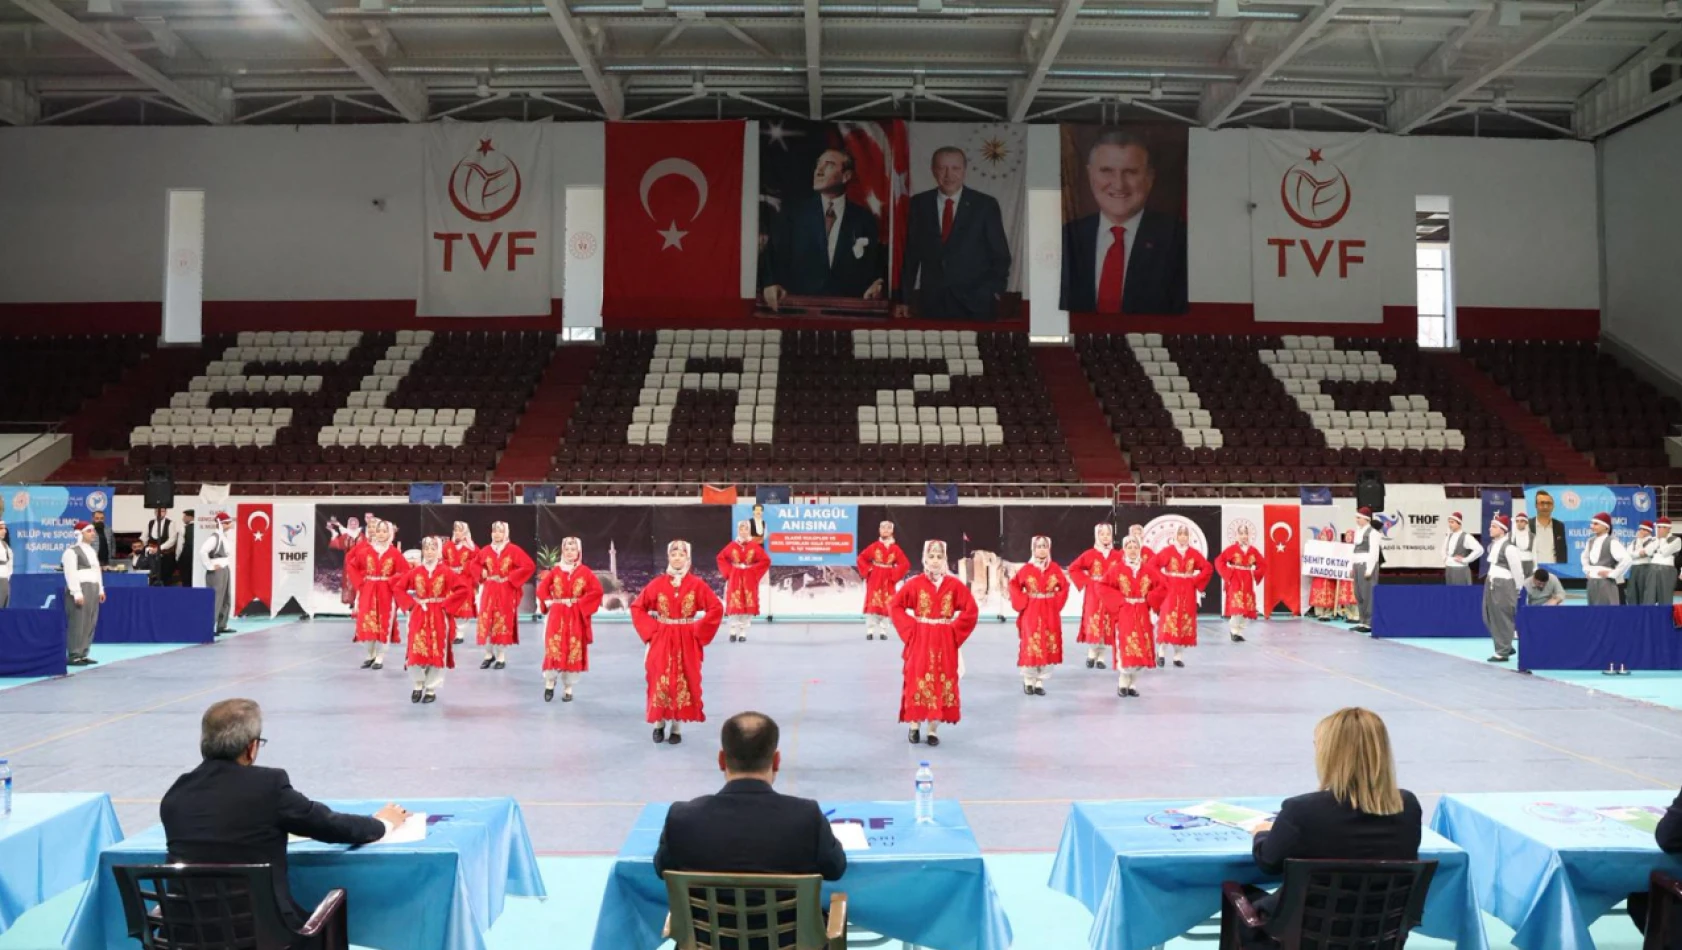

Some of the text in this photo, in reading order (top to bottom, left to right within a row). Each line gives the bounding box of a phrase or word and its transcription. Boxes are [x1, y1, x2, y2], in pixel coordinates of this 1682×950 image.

[433, 231, 537, 272] TVF
[1267, 238, 1366, 278] TVF
[778, 507, 849, 518] ALİ AKGÜL
[782, 520, 836, 530] ANISINA
[1408, 514, 1440, 525] THOF
[278, 552, 308, 561] THOF
[1310, 566, 1343, 578] ANADOLU
